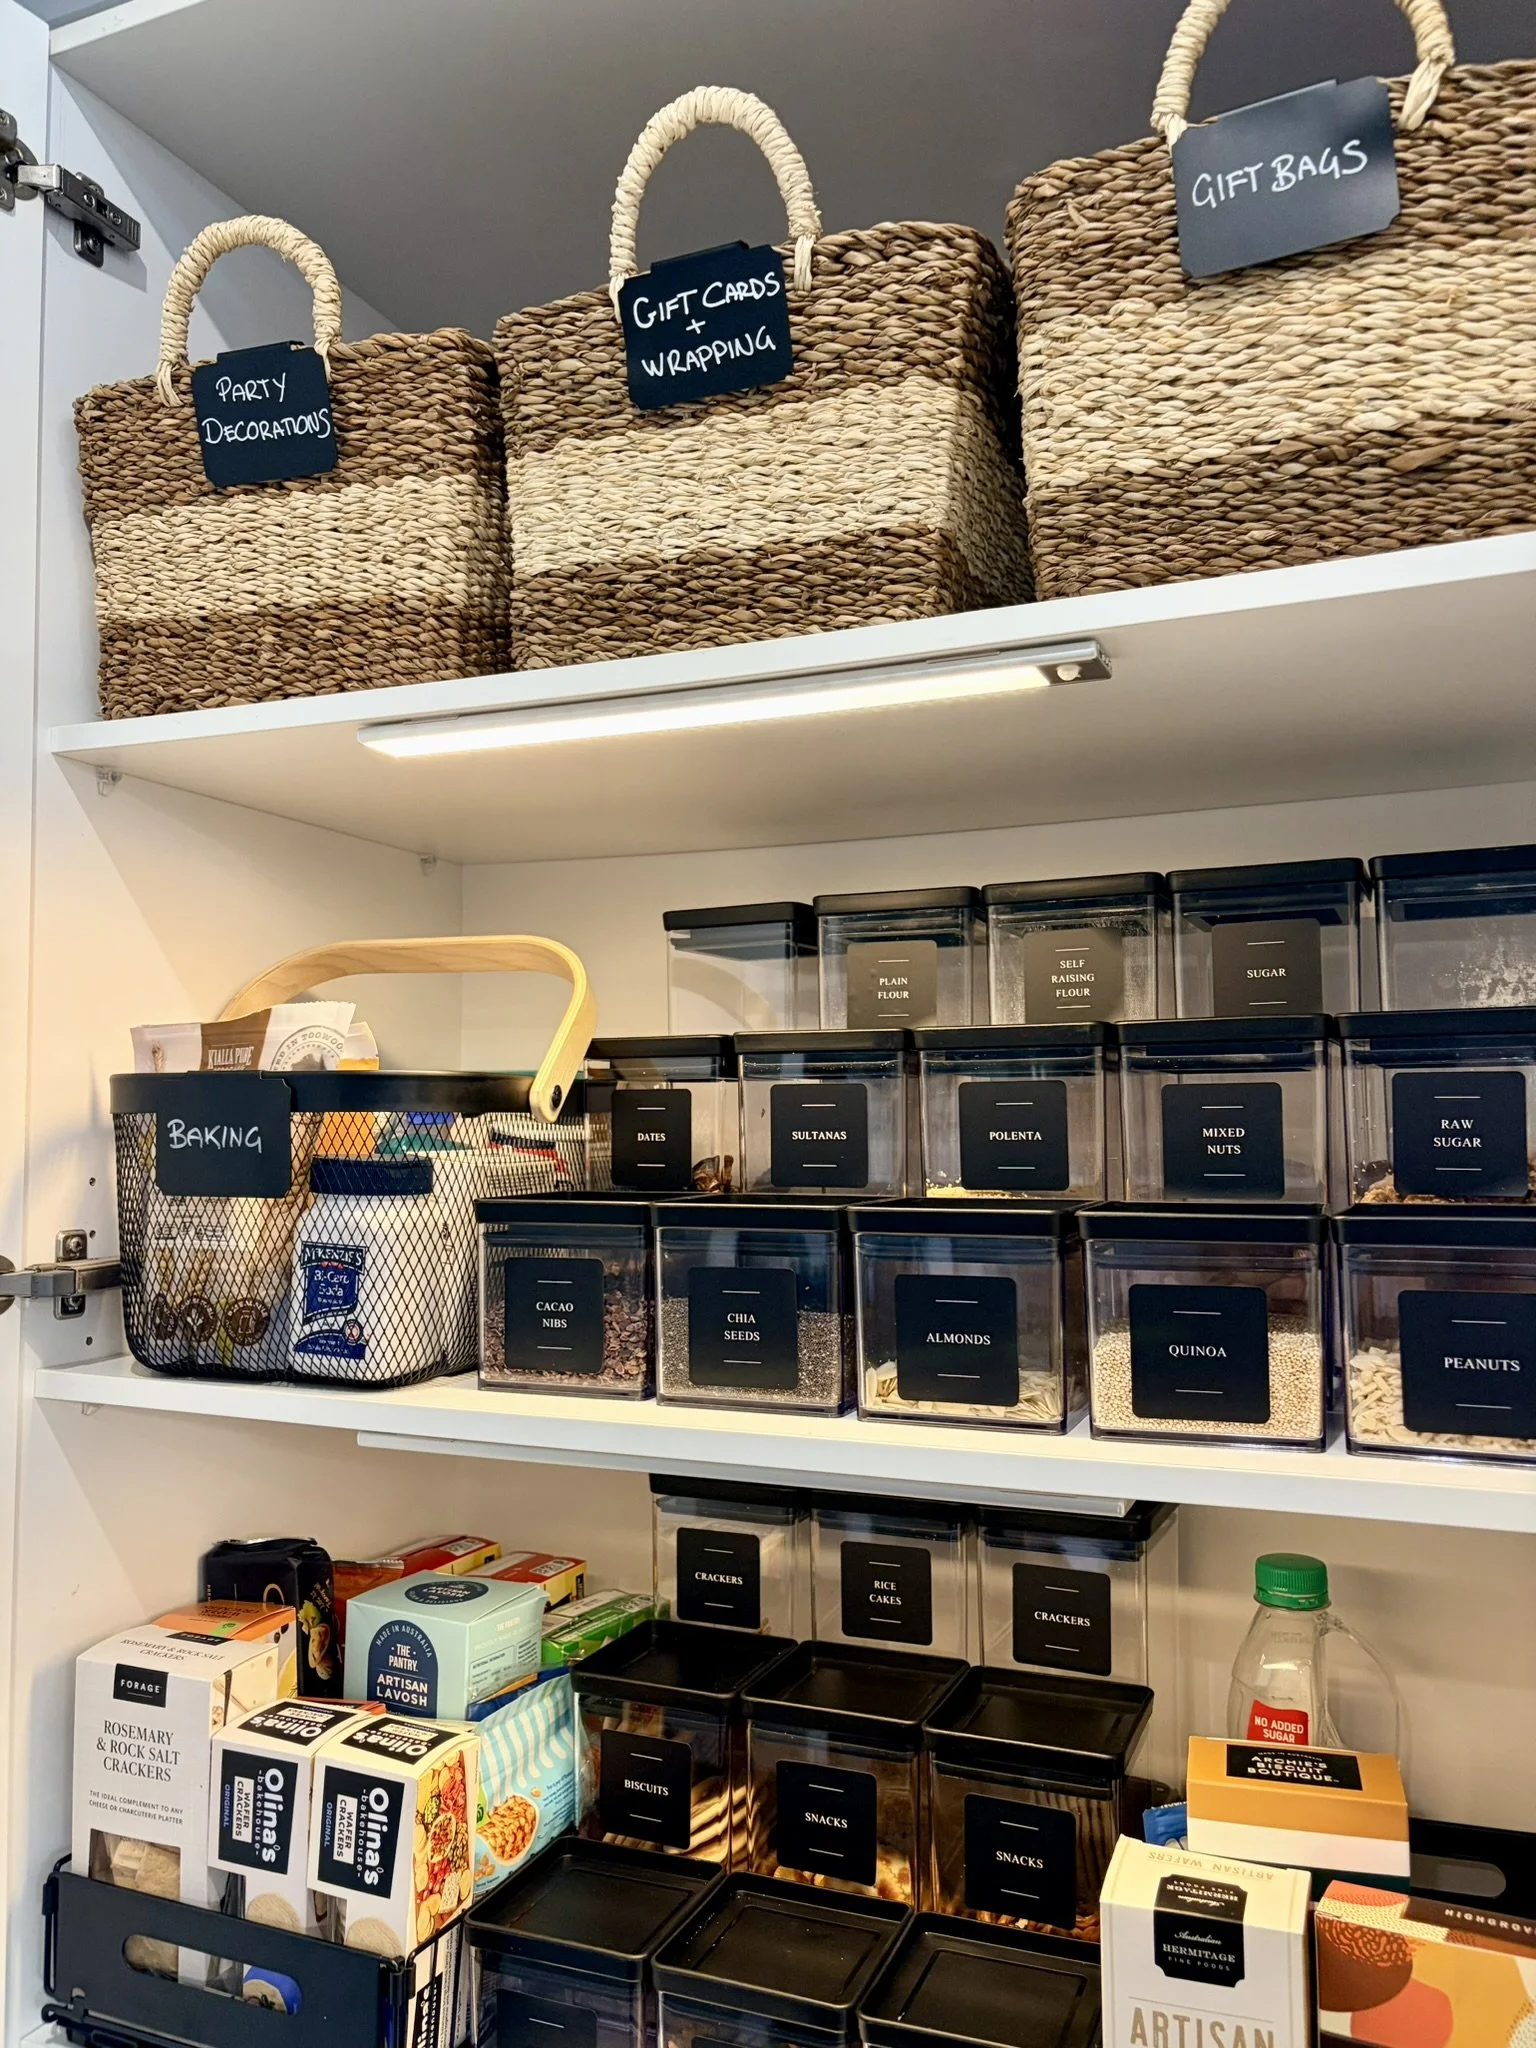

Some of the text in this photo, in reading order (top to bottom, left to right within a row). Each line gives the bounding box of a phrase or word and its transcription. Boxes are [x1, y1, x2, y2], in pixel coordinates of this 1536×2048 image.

[1191, 139, 1368, 209] GIFT BAGS
[632, 271, 781, 329] GIFT CARDS
[641, 325, 776, 377] WRAPPING
[215, 372, 286, 403] PARTY
[201, 408, 331, 445] DECORATIONS
[1059, 958, 1085, 970] SELF
[1246, 967, 1287, 979] SUGAR
[878, 975, 909, 987] PLAIN
[1050, 972, 1096, 984] RAISING
[877, 989, 910, 1000] FLOUR
[1055, 987, 1091, 998] FLOUR
[301, 1031, 344, 1053] TOOWOO
[1202, 1126, 1245, 1138] MIXED
[1440, 1118, 1474, 1130] RAW
[166, 1118, 263, 1154] BAKING
[636, 1131, 666, 1143] DATES
[791, 1130, 847, 1142] SULTANAS
[988, 1130, 1042, 1142] POLENTA
[1433, 1136, 1482, 1148] SUGAR
[1207, 1143, 1241, 1155] NUTS
[535, 1301, 574, 1312] CACAO
[541, 1317, 568, 1328] NIBS
[727, 1312, 756, 1324] CHIA
[724, 1330, 760, 1341] SEEDS
[925, 1332, 991, 1346] ALMONDS
[1168, 1343, 1227, 1359] QUINOA
[1443, 1356, 1521, 1372] PEANUTS
[694, 1571, 743, 1586] CRACKERS
[873, 1579, 897, 1591] RICE
[869, 1593, 902, 1606] CAKES
[1033, 1610, 1091, 1628] CRACKERS
[375, 1624, 433, 1658] MADE IN AUSTRALIA
[396, 1643, 411, 1658] THE
[120, 1678, 162, 1694] FORAGE
[376, 1673, 428, 1694] ARTISAN
[376, 1685, 428, 1707] LAVOSH
[103, 1719, 174, 1746] ROSEMARY
[250, 1715, 322, 1738] Olina's
[1254, 1715, 1304, 1734] NO ADDED
[352, 1731, 428, 1756] Olina's
[1263, 1728, 1296, 1744] SUGAR
[96, 1736, 181, 1766] & ROCK SALT
[103, 1756, 172, 1782] CRACKERS
[1251, 1755, 1328, 1769] ARCHIE'S
[1256, 1761, 1324, 1774] BISCUIT
[623, 1778, 669, 1797] BISCUITS
[90, 1789, 184, 1815] THE IDEAL COMPLEMENT TO ANY
[223, 1783, 231, 1828] ORIGINAL
[234, 1780, 245, 1837] CRACKERS
[243, 1792, 251, 1830] WAFER
[89, 1799, 184, 1825] CHEESE OR CHARCUTERIE PLATTER
[261, 1767, 285, 1864] Olina's
[804, 1811, 848, 1829] SNACKS
[323, 1801, 333, 1848] ORIGINAL
[336, 1798, 347, 1858] CRACKERS
[344, 1811, 354, 1849] WAFER
[363, 1786, 391, 1887] Olina's
[995, 1850, 1044, 1869] SNACKS
[1148, 1851, 1274, 1881] ARTISAN WAFERS
[1444, 1908, 1536, 1935] HIGHGROV
[1174, 1930, 1222, 1945] Australian
[1162, 1943, 1236, 1964] HERMITAGE
[1168, 1956, 1231, 1972] FINE FOODS
[416, 1985, 432, 2048] lina's
[1130, 2007, 1275, 2048] ARTISAN
